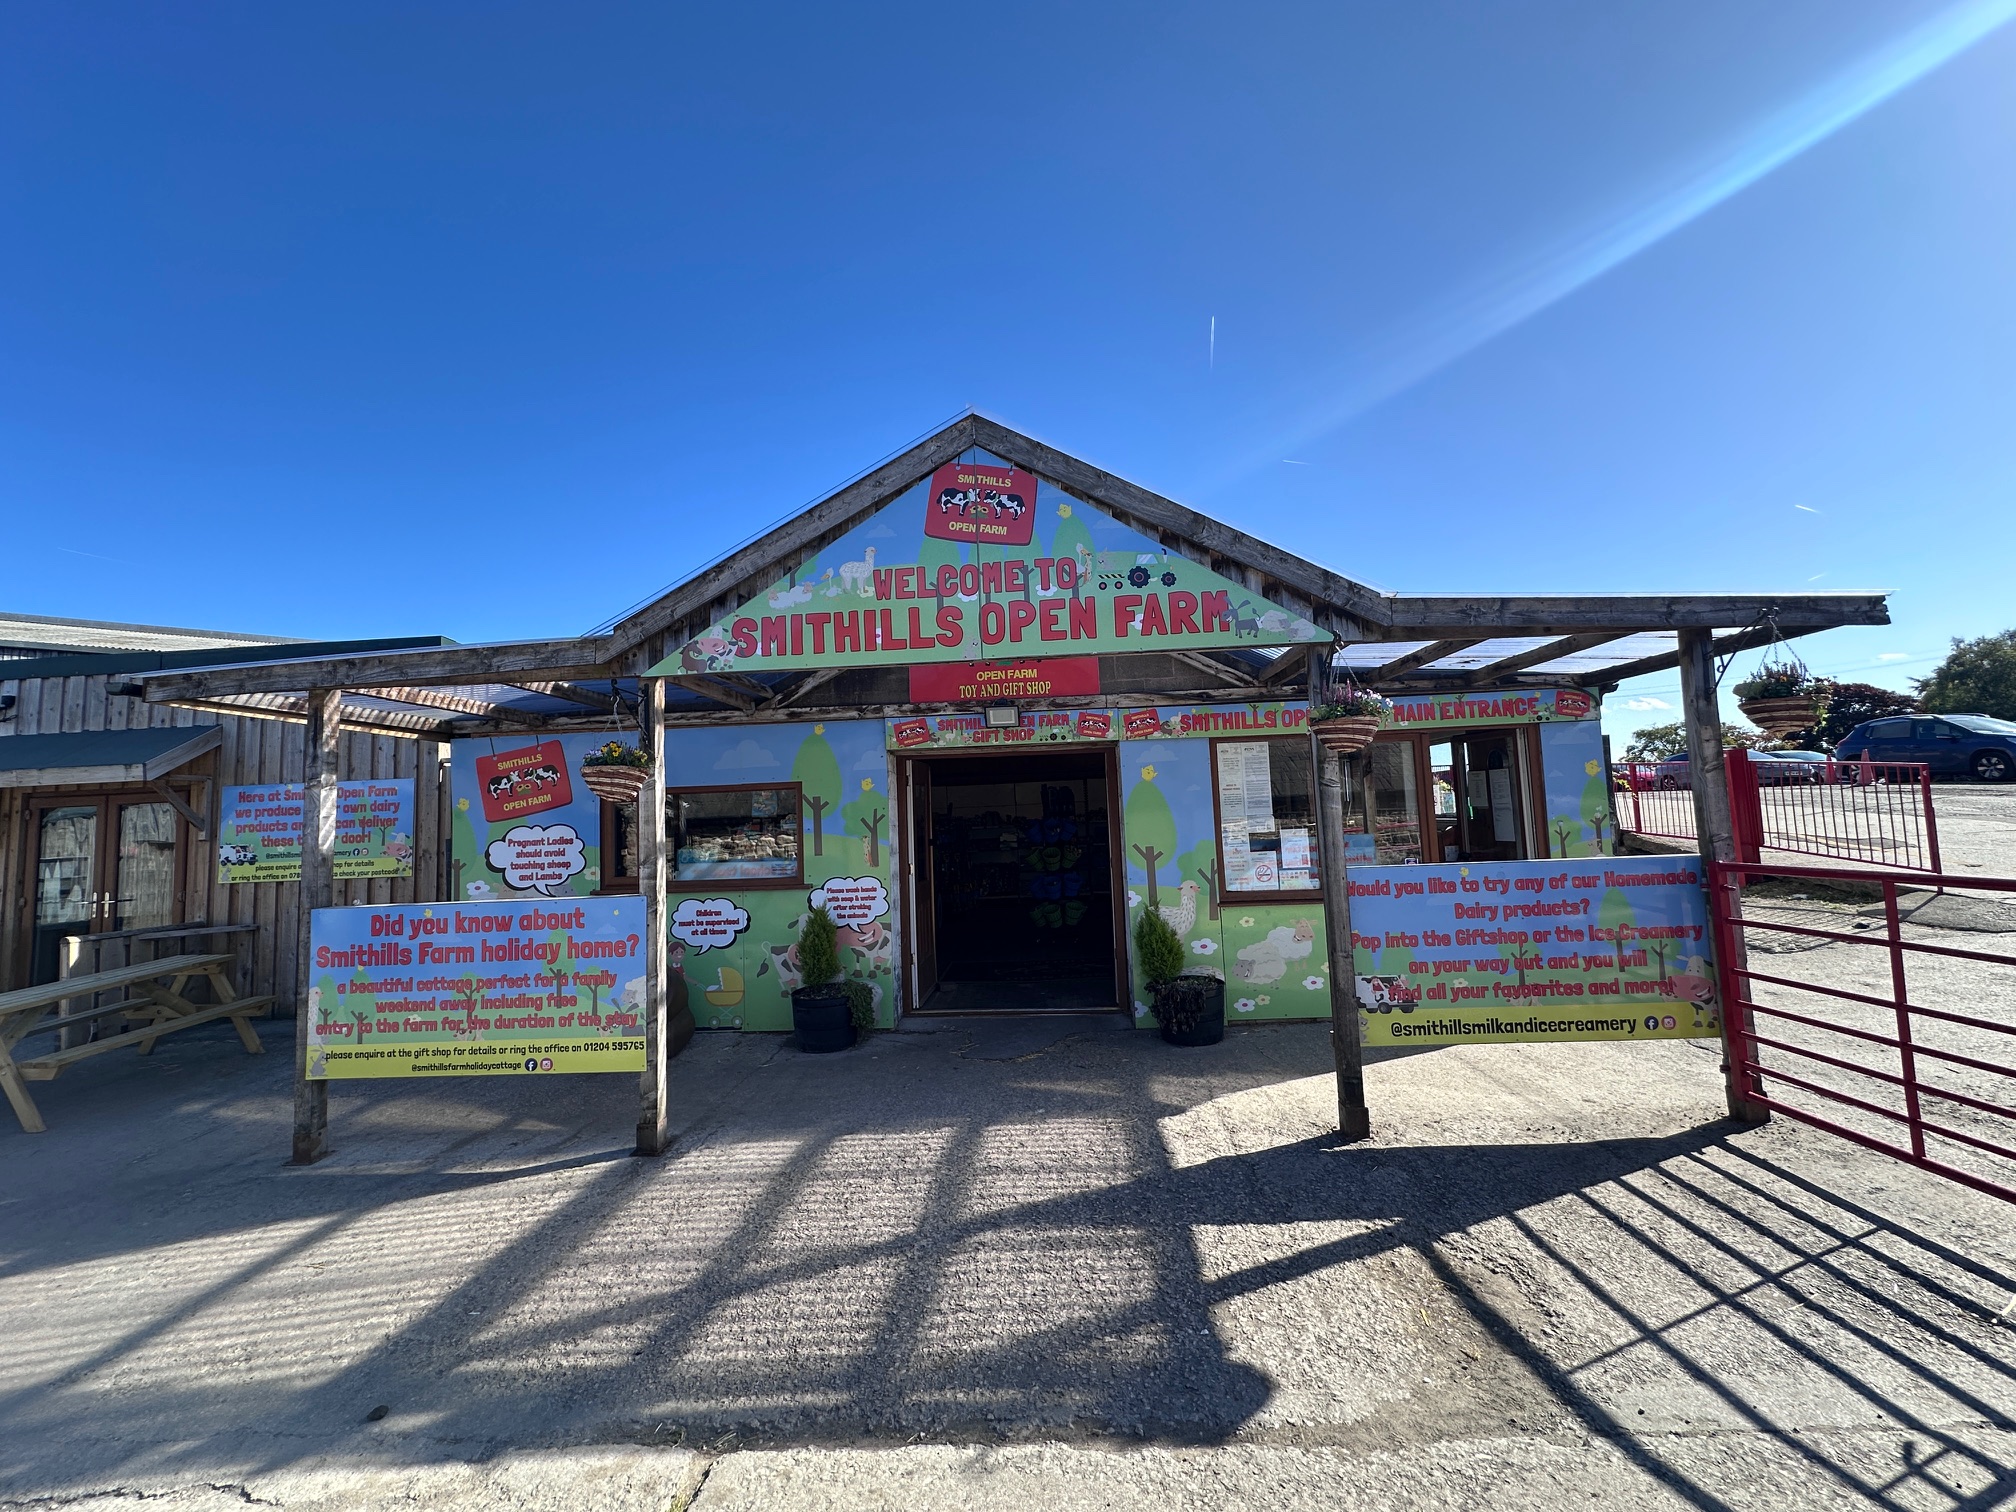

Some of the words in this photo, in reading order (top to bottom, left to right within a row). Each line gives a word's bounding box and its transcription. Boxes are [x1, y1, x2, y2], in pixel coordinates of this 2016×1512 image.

[957, 474, 1011, 487] SMITHILLS
[949, 521, 976, 533] OPEN
[979, 524, 1007, 535] FARM
[873, 559, 1025, 600] WELCOME
[1034, 557, 1078, 590] TO
[731, 606, 964, 657] SMITHILLS
[981, 596, 1097, 645] OPEN
[1114, 590, 1231, 637] FARM
[976, 670, 1005, 681] OPEN
[1008, 668, 1037, 679] FARM
[959, 684, 977, 698] TOY
[980, 683, 1000, 697] AND
[1002, 682, 1025, 696] GIFT
[1026, 681, 1051, 695] SHOP
[1393, 702, 1436, 722] MAIN
[1441, 697, 1540, 720] ENTRANCE
[1039, 714, 1070, 727] FARM
[1180, 710, 1276, 732] SMITHILLS
[973, 729, 1000, 743] GIFT
[1003, 728, 1035, 741] SHOP
[497, 753, 543, 770] SMITHILLS
[238, 791, 265, 803] Here
[268, 790, 281, 801] at
[337, 787, 365, 801] Open
[368, 785, 397, 797] Farm
[503, 801, 526, 811] OPEN
[528, 793, 552, 805] FARM
[235, 808, 252, 818] we
[254, 805, 301, 820] produce
[343, 803, 366, 813] own
[370, 800, 400, 813] dairy
[236, 821, 288, 836] products
[359, 815, 399, 827] deliver
[261, 835, 294, 847] these
[341, 831, 371, 844] door!
[507, 837, 545, 848] Pregnant
[547, 836, 574, 846] Ladies
[515, 849, 542, 858] should
[544, 848, 566, 857] avoid
[255, 864, 274, 872] please
[275, 863, 297, 871] enquire
[510, 860, 545, 871] touching
[547, 860, 571, 870] sheep
[518, 872, 534, 881] and
[535, 872, 562, 880] Lambs
[1347, 879, 1391, 897] Would
[1394, 881, 1424, 898] you
[1428, 877, 1457, 894] like
[1461, 876, 1479, 892] to
[1483, 876, 1509, 894] try
[1514, 877, 1544, 893] any
[1549, 873, 1567, 889] of
[1571, 874, 1600, 888] our
[1604, 868, 1697, 888] Homemade
[1454, 902, 1498, 922] Dairy
[1503, 898, 1590, 921] products?
[370, 913, 403, 937] Did
[408, 917, 448, 940] you
[455, 911, 513, 933] know
[519, 907, 585, 931] about
[1351, 932, 1381, 953] Pop
[1385, 931, 1418, 948] into
[1422, 930, 1451, 947] the
[1455, 927, 1528, 947] Giftshop
[1532, 929, 1551, 942] or
[1554, 925, 1584, 942] the
[1588, 925, 1615, 942] Ice
[1619, 922, 1703, 941] Creamery
[316, 942, 412, 968] Smithills
[418, 942, 474, 964] Farm
[481, 938, 561, 965] holiday
[567, 934, 639, 959] home?
[1408, 960, 1429, 974] on
[1433, 958, 1471, 976] your
[1474, 957, 1509, 974] way
[1514, 953, 1543, 971] out
[1547, 952, 1579, 969] and
[1583, 954, 1613, 972] you
[1618, 949, 1647, 967] will
[337, 982, 346, 994] a
[349, 977, 413, 994] beautiful
[417, 976, 472, 994] cottage
[476, 974, 530, 993] perfect
[534, 972, 557, 987] for
[560, 975, 568, 986] a
[572, 970, 617, 988] family
[1388, 984, 1422, 1001] find
[1426, 982, 1447, 1000] all
[1450, 985, 1489, 1002] your
[1492, 980, 1583, 999] favourites
[1588, 978, 1620, 995] and
[1625, 976, 1674, 995] more!
[375, 997, 435, 1013] weekend
[439, 998, 477, 1013] away
[481, 994, 542, 1011] including
[546, 993, 577, 1007] free
[316, 1020, 354, 1037] entry
[357, 1019, 372, 1033] to
[376, 1018, 399, 1033] the
[403, 1018, 437, 1032] farm
[441, 1016, 463, 1031] for
[467, 1015, 490, 1030] the
[494, 1013, 554, 1029] duration
[558, 1012, 574, 1027] of
[577, 1011, 601, 1027] the
[605, 1010, 638, 1028] stay
[1391, 1016, 1637, 1037] @smithillsmilkandicecreamery
[325, 1050, 352, 1061] please
[354, 1048, 385, 1060] enquire
[387, 1048, 396, 1058] at
[398, 1047, 412, 1057] the
[414, 1047, 429, 1060] gift
[431, 1047, 451, 1058] shop
[453, 1046, 466, 1056] for
[468, 1045, 497, 1056] details
[499, 1046, 508, 1054] or
[509, 1044, 526, 1056] ring
[528, 1044, 542, 1054] the
[544, 1043, 569, 1053] office
[571, 1044, 582, 1052] on
[583, 1042, 610, 1052] 01204
[611, 1041, 645, 1051] 595765
[411, 1061, 522, 1072] @smithillsfarmholidaycottage
